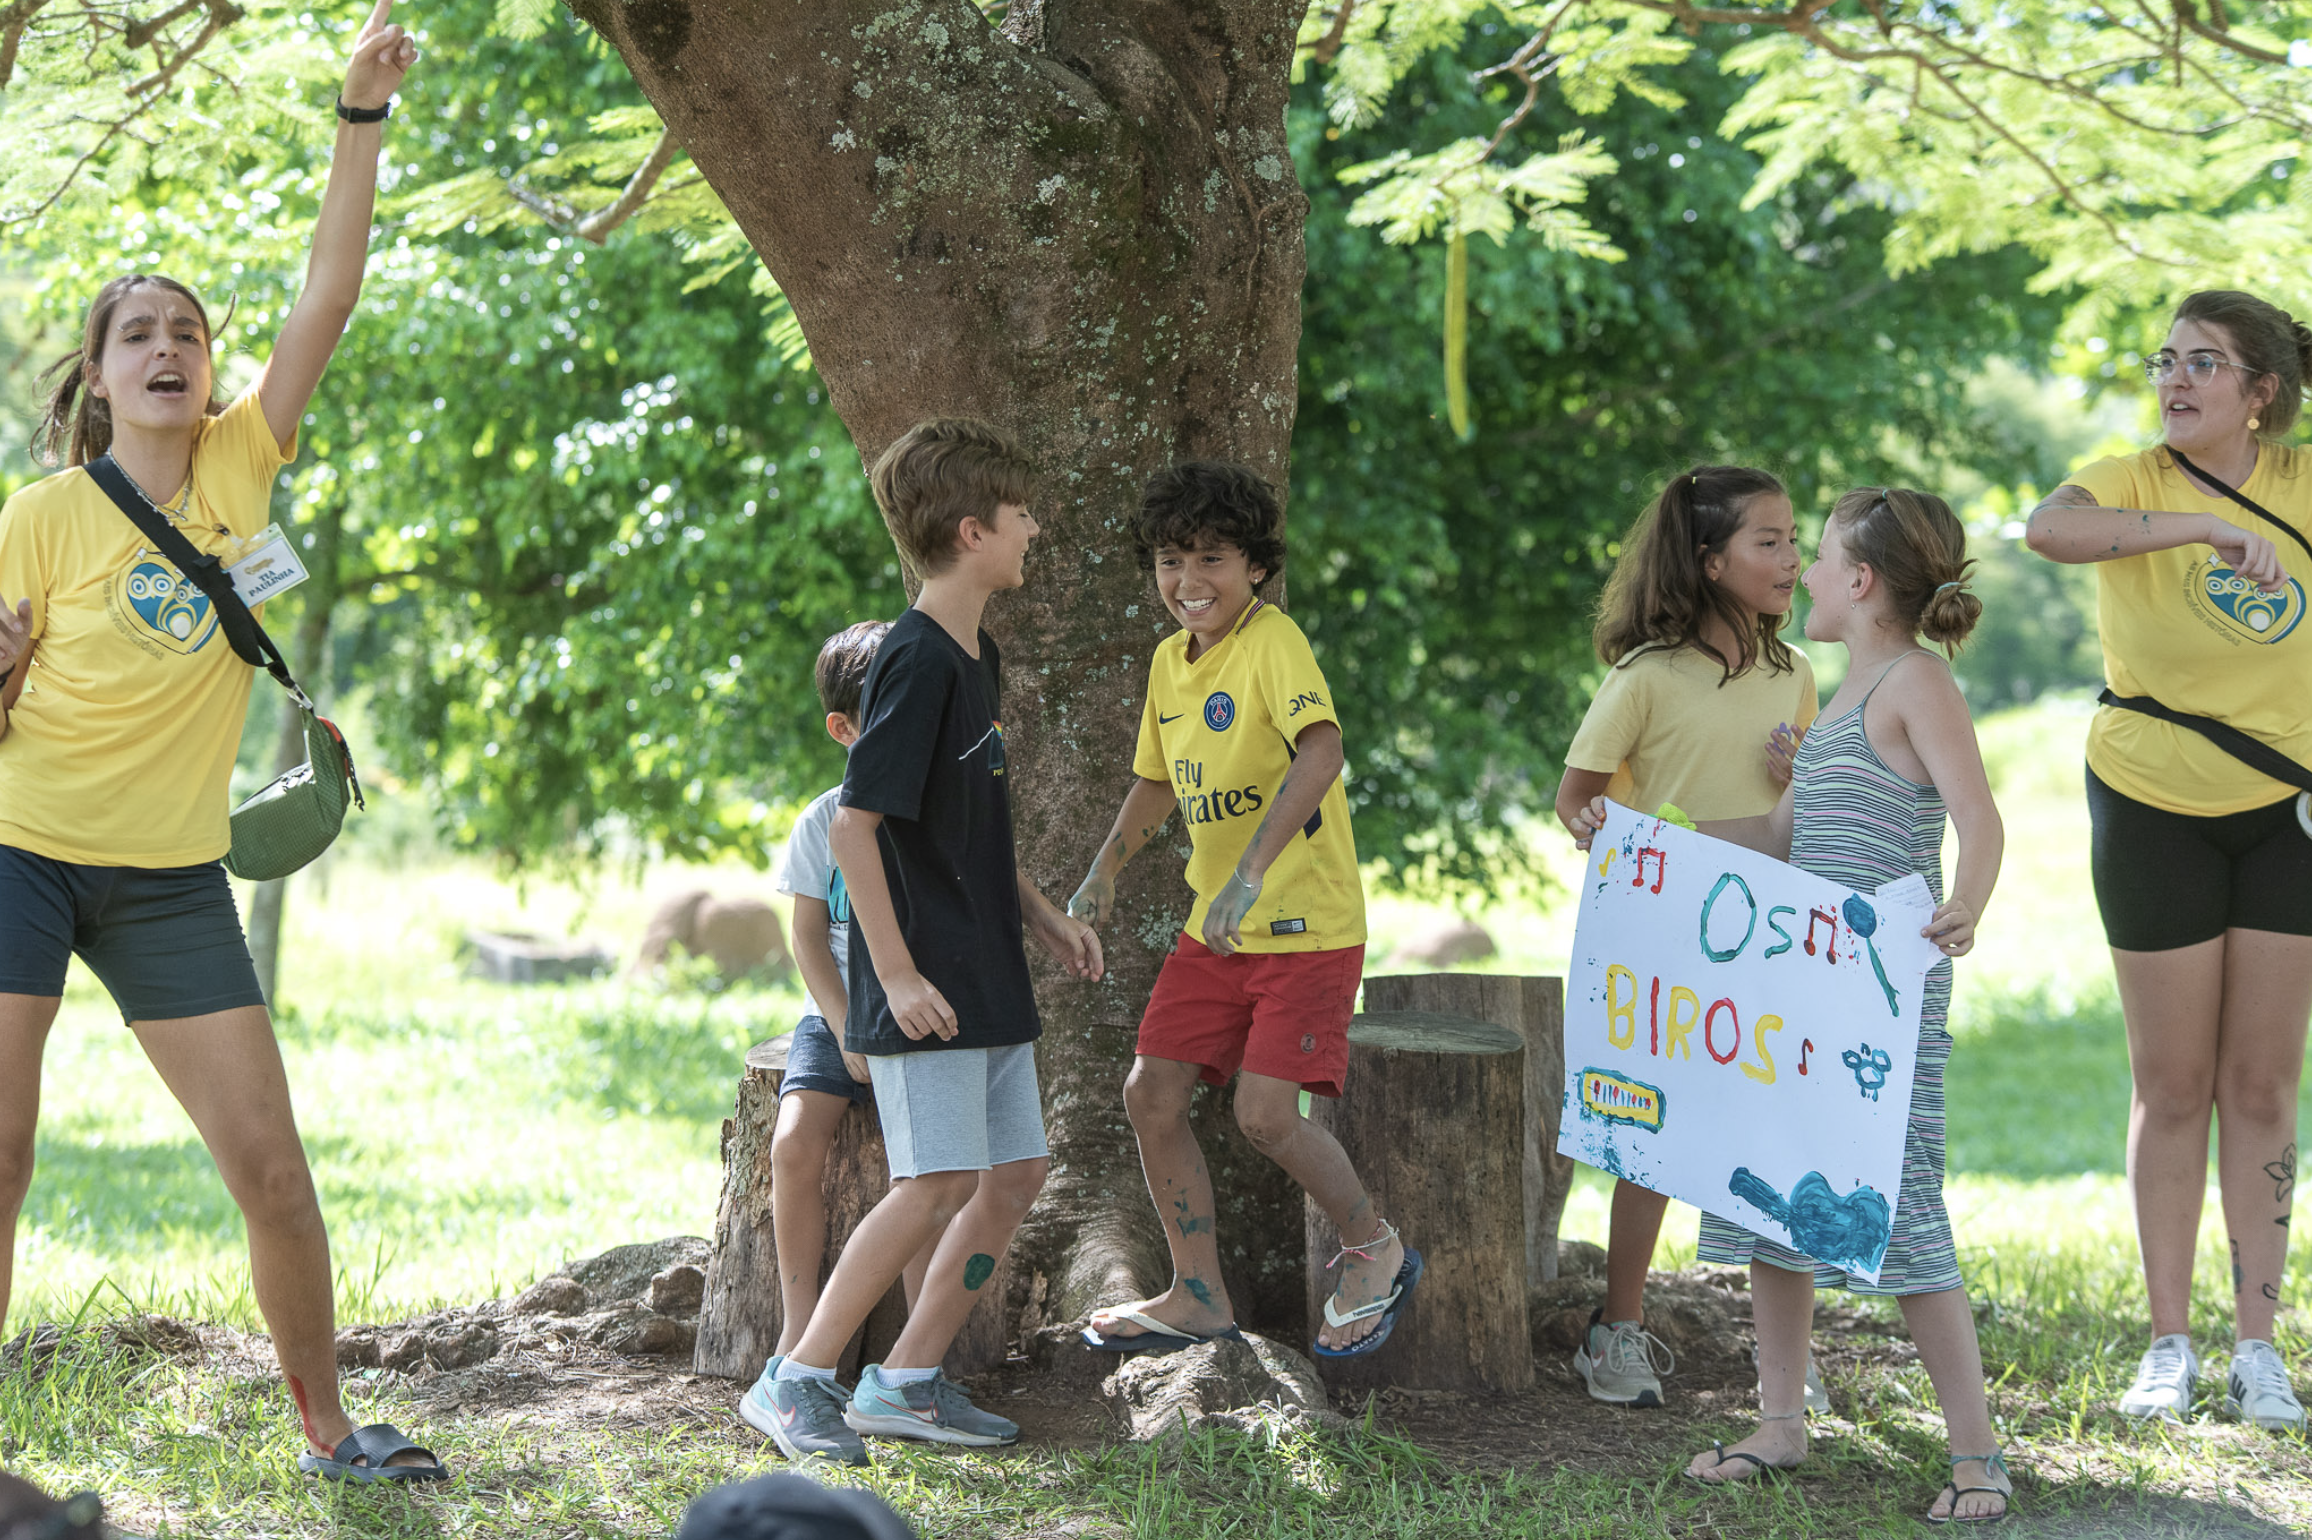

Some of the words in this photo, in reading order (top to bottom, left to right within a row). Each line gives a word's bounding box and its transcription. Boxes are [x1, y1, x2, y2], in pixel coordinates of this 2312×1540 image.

[248, 568, 295, 597] PAULINHA
[259, 570, 276, 582] TIA
[1175, 758, 1203, 788] Fly
[1176, 785, 1263, 825] irates
[1700, 872, 1796, 963] Os
[1606, 964, 1784, 1085] BIROS
